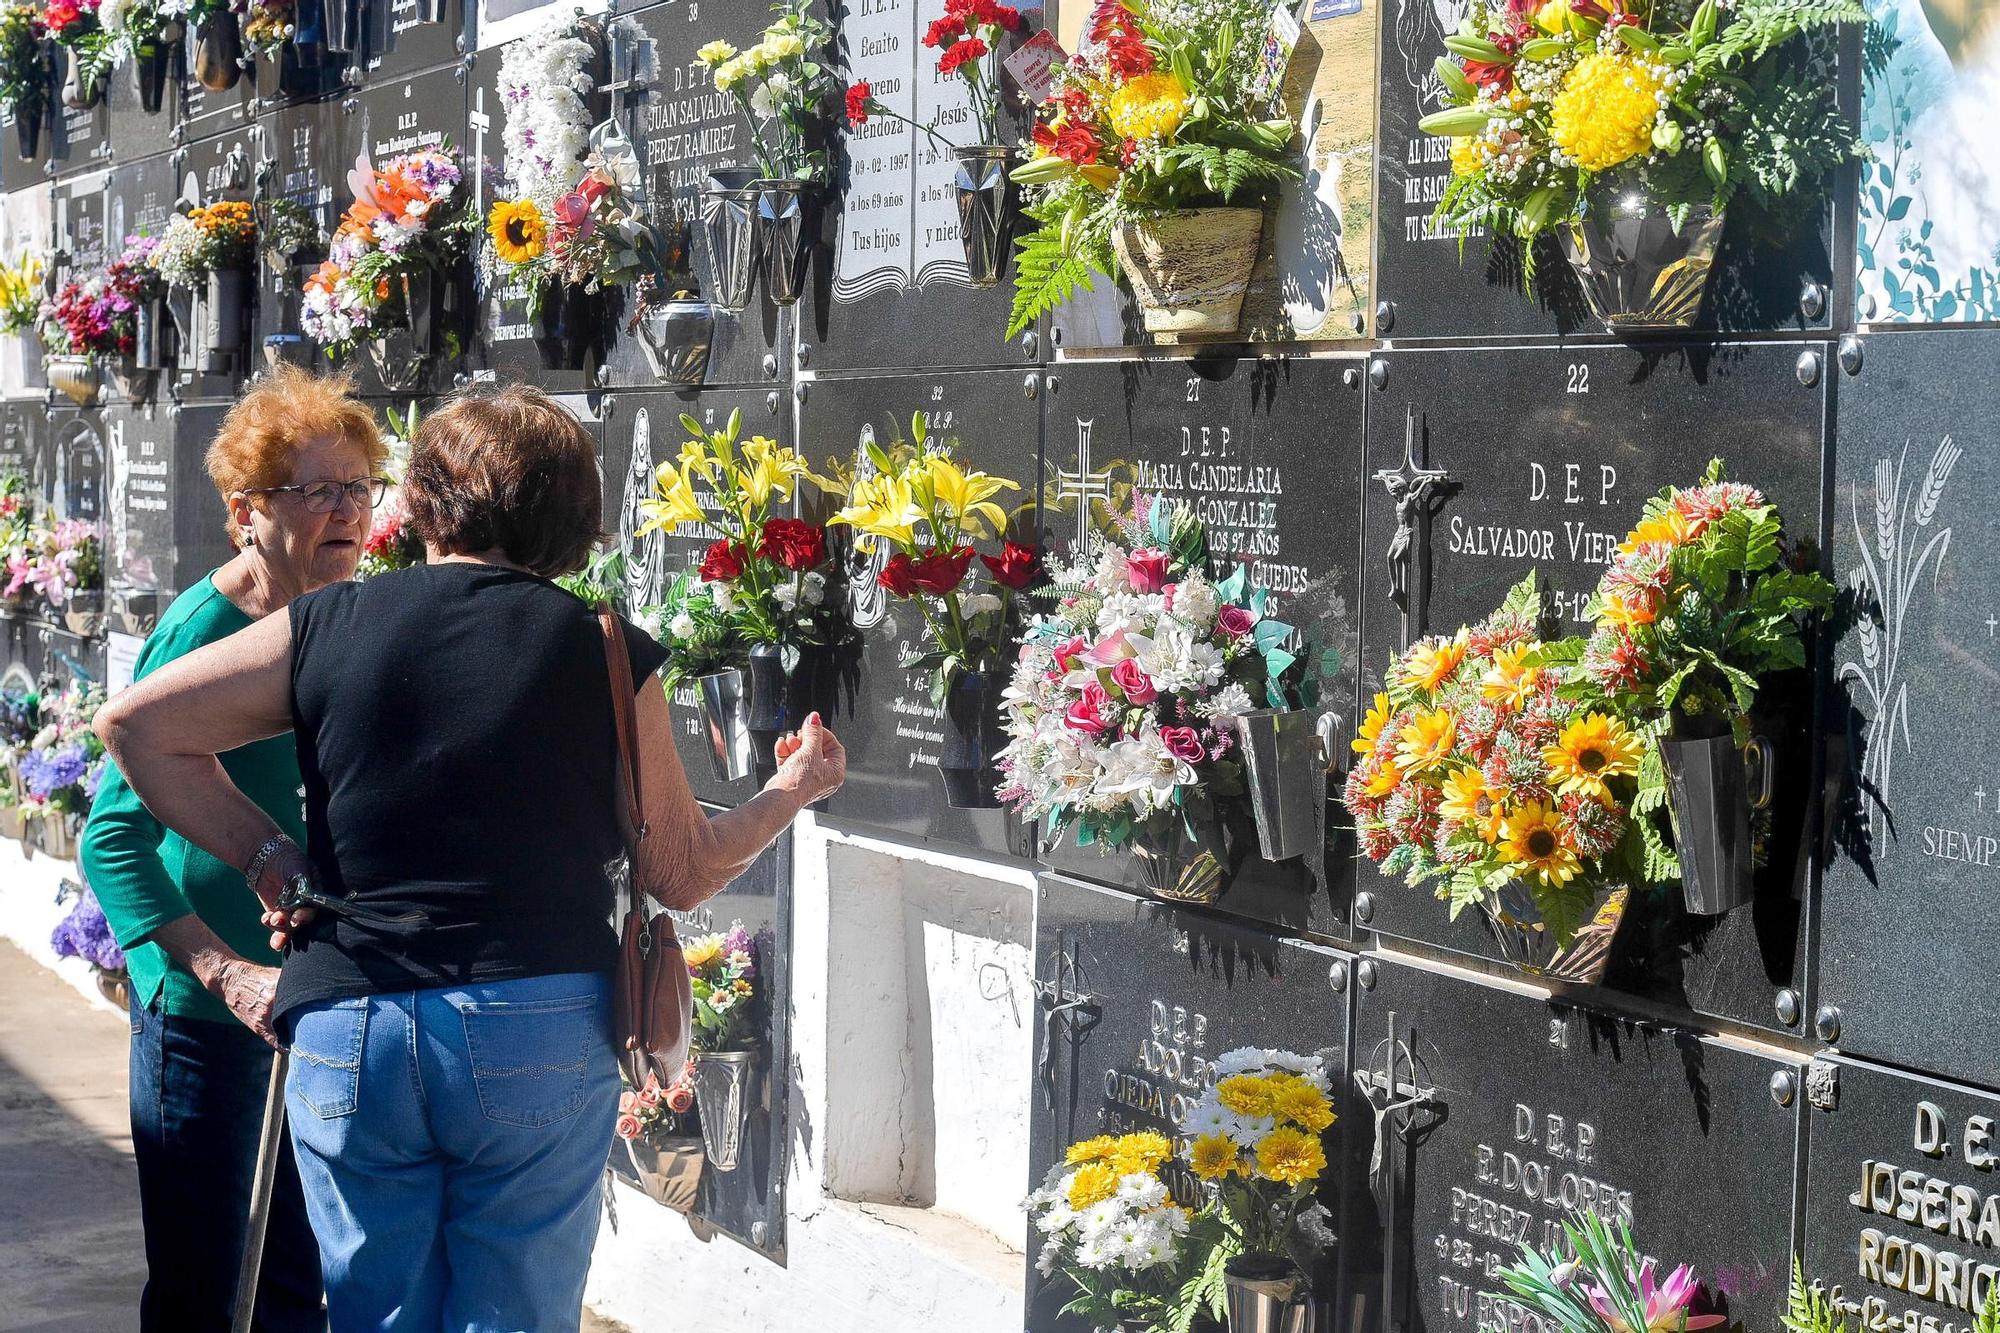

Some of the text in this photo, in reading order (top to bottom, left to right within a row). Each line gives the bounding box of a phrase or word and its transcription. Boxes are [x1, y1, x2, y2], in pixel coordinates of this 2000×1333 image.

[688, 2, 699, 22] 38
[860, 32, 899, 58] Benito
[674, 67, 684, 92] D.
[858, 77, 901, 98] oreno
[648, 90, 737, 132] JUAN SALVADOR
[933, 101, 968, 127] Jesús
[647, 124, 736, 166] PEREZ RAMIREZ
[1407, 135, 1452, 165] AL DESP
[684, 165, 700, 188] LOS
[889, 153, 909, 172] 1997
[850, 191, 904, 212] a los 69 años
[920, 182, 955, 203] a los 70
[1404, 177, 1421, 204] ME
[852, 228, 901, 253] Tus hijos
[925, 220, 964, 248] y nieto
[1405, 215, 1420, 242] TU
[1186, 377, 1201, 402] 27
[1566, 363, 1590, 394] 22
[931, 385, 944, 401] 32
[705, 408, 714, 425] 37
[1180, 426, 1235, 458] D. E. P.
[1136, 459, 1283, 495] MARIA CANDELARIA
[1529, 462, 1621, 505] D. E. P.
[1196, 495, 1278, 530] GONZALEZ
[668, 519, 705, 539] ZORLA
[1208, 528, 1280, 556] LOS 97 AÑOS
[1450, 515, 1623, 565] SALVADOR VIER
[1251, 558, 1309, 594] GUEDES
[674, 686, 699, 709] CAZO
[1923, 826, 2000, 867] SIEMP
[1549, 1018, 1568, 1050] 21
[1514, 1103, 1593, 1165] D. E. P.
[1913, 1100, 2000, 1173] D. E.
[1450, 1186, 1533, 1248] PEREZ
[1438, 1275, 1473, 1321] TU
